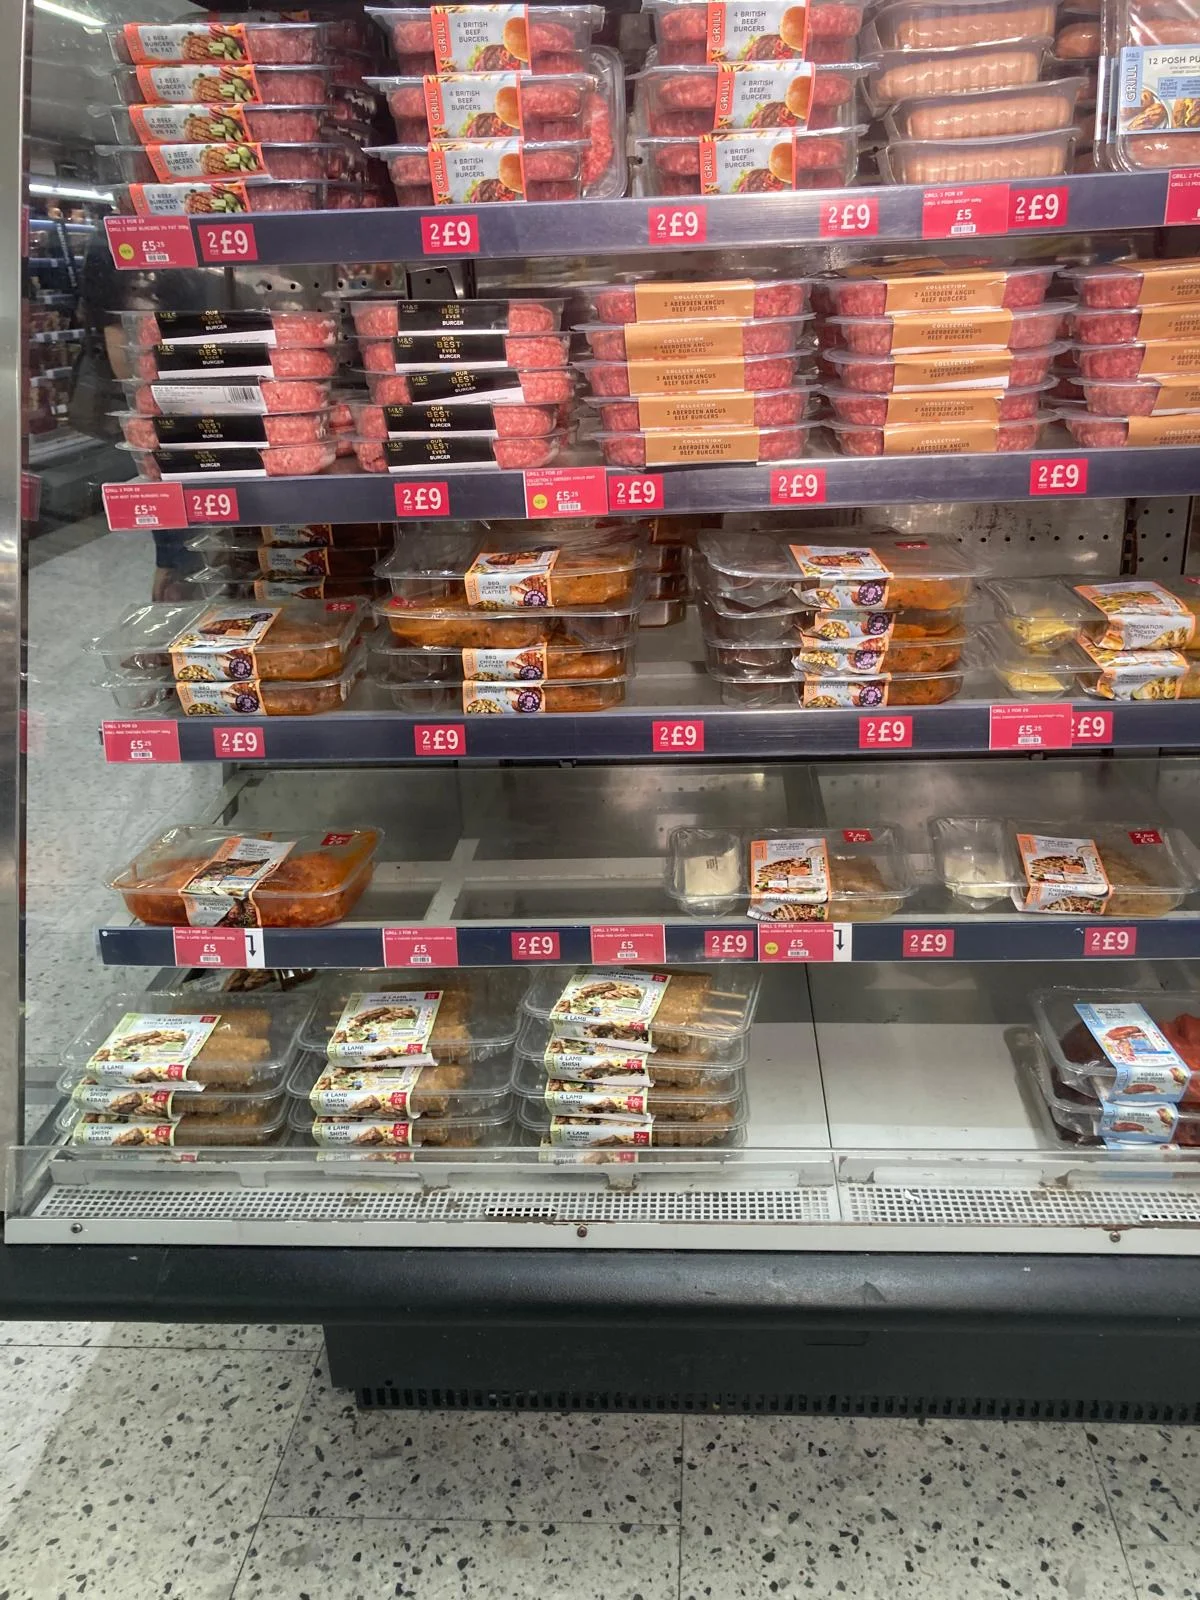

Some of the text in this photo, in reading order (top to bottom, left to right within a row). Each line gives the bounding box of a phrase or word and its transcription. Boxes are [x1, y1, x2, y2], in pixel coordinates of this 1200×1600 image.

[438, 21, 447, 52] GRILL
[712, 9, 722, 43] GRILL
[1126, 65, 1137, 102] GRILL
[428, 90, 440, 120] GRILL
[720, 80, 730, 110] GRILL
[434, 159, 444, 188] GRILL
[703, 150, 712, 178] GRILL
[828, 204, 870, 229] 2 £9
[956, 209, 972, 221] £5
[1016, 193, 1059, 220] 2 £9
[430, 221, 470, 246] 2 £9
[657, 211, 698, 236] 2 £9
[208, 230, 248, 254] 2 £9
[779, 474, 818, 497] 2 £9
[1038, 464, 1079, 488] 2 £9
[403, 488, 441, 510] 2 £9
[617, 481, 655, 503] 2 £9
[193, 494, 230, 515] 2 £9
[660, 725, 696, 745] 2 £9
[867, 722, 904, 742] 2 £9
[1078, 717, 1105, 737] £9
[222, 732, 257, 752] 2 £9
[422, 730, 458, 750] 2 £9
[204, 944, 216, 952] £5
[414, 944, 427, 953] £5
[519, 936, 553, 954] 2 £9
[621, 941, 634, 949] £5
[712, 935, 746, 952] 2 £9
[910, 934, 946, 951] 2 £9
[1092, 931, 1128, 950] 2 £9
